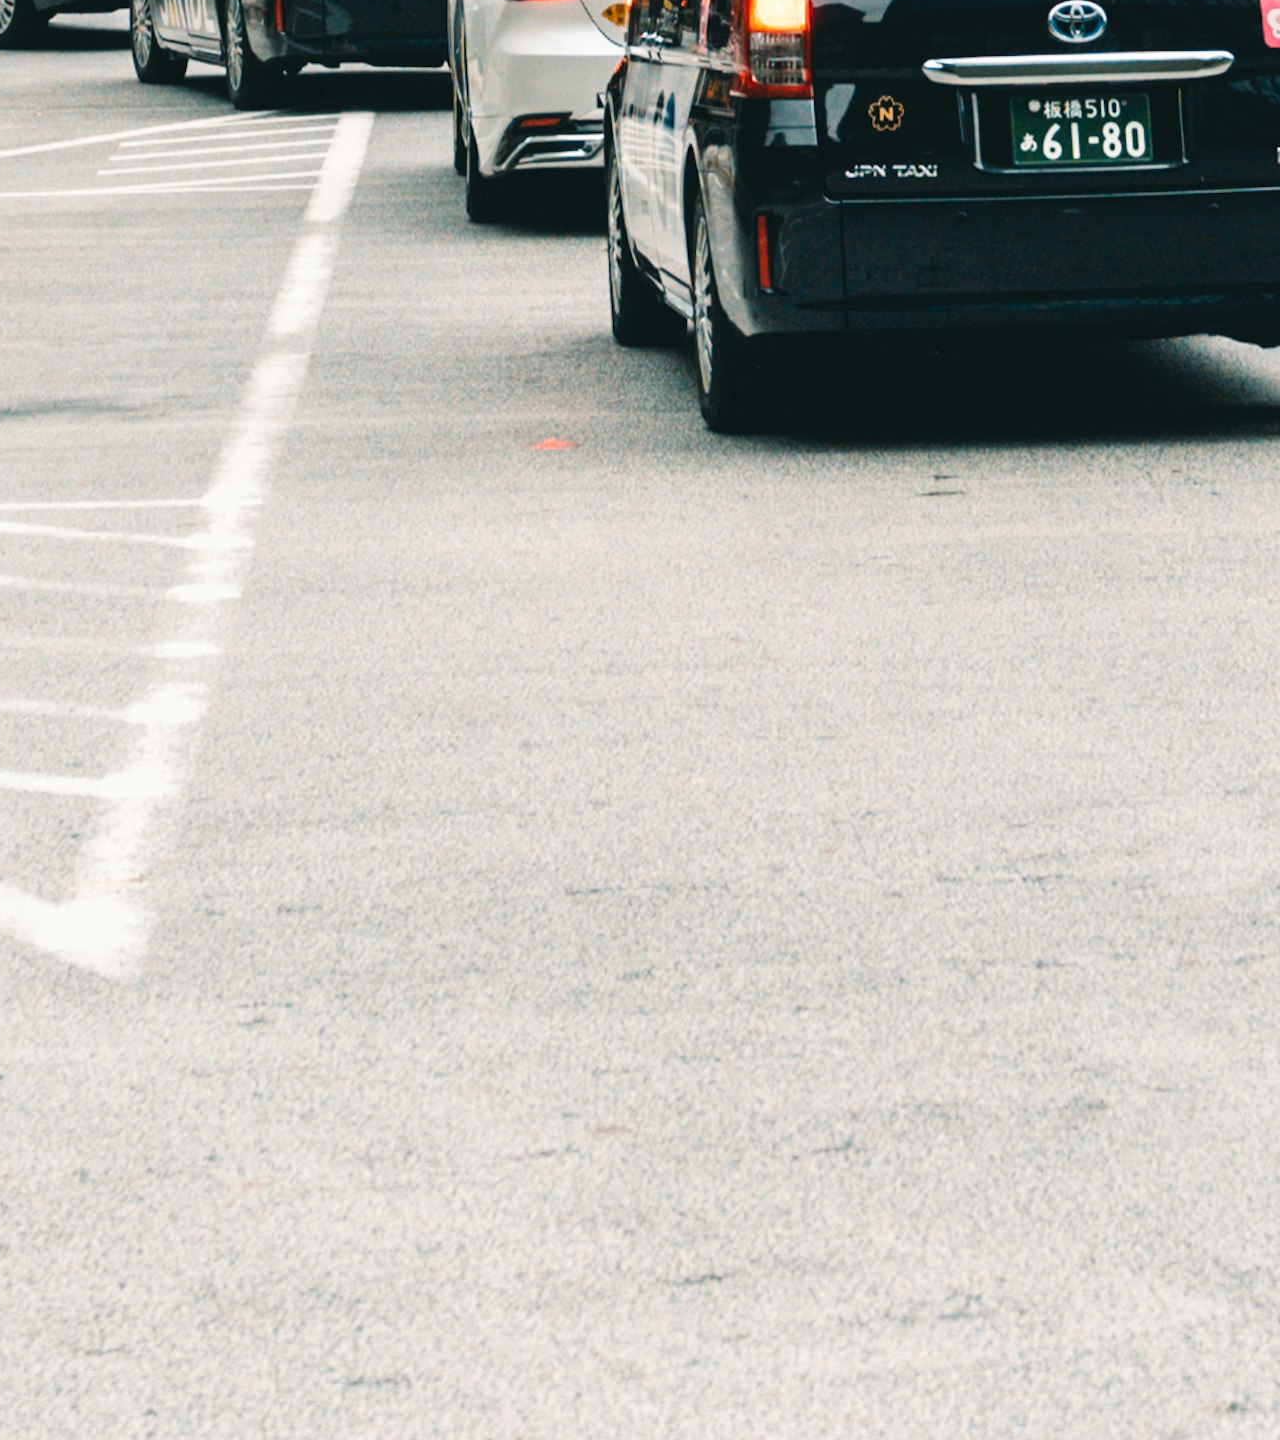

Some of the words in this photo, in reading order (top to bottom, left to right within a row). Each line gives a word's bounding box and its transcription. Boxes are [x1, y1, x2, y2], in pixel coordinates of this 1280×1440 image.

[878, 107, 894, 122] N
[1042, 120, 1147, 161] 61-80
[844, 165, 887, 179] JPN
[892, 164, 938, 178] TAXI
